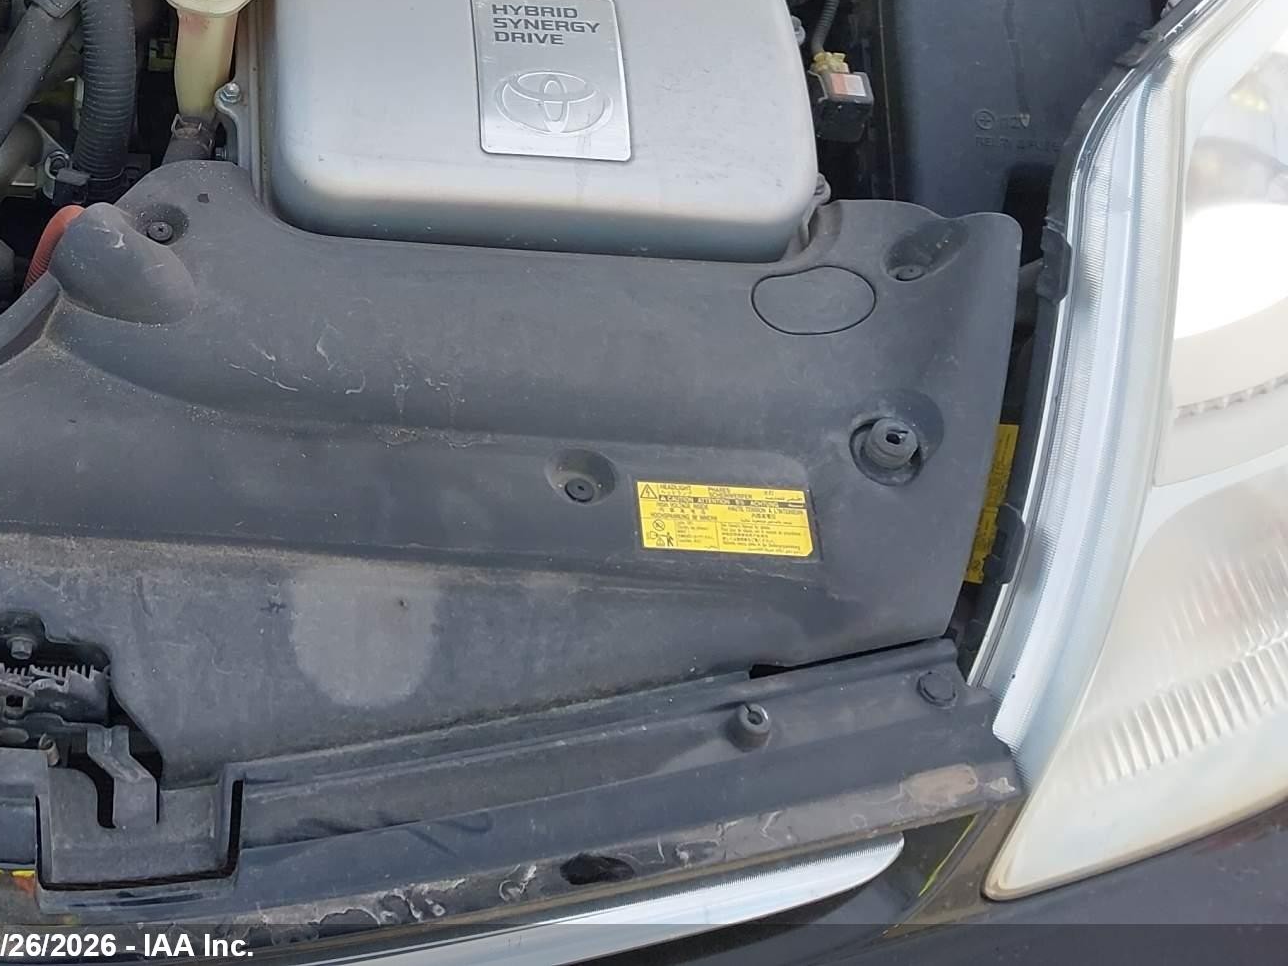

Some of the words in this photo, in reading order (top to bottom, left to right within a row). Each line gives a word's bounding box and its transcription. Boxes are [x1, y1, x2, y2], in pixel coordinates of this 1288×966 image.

[492, 4, 578, 19] HYBRID
[493, 18, 600, 33] SYNERGY
[494, 31, 564, 45] DRIVE
[666, 495, 694, 503] CAUTION
